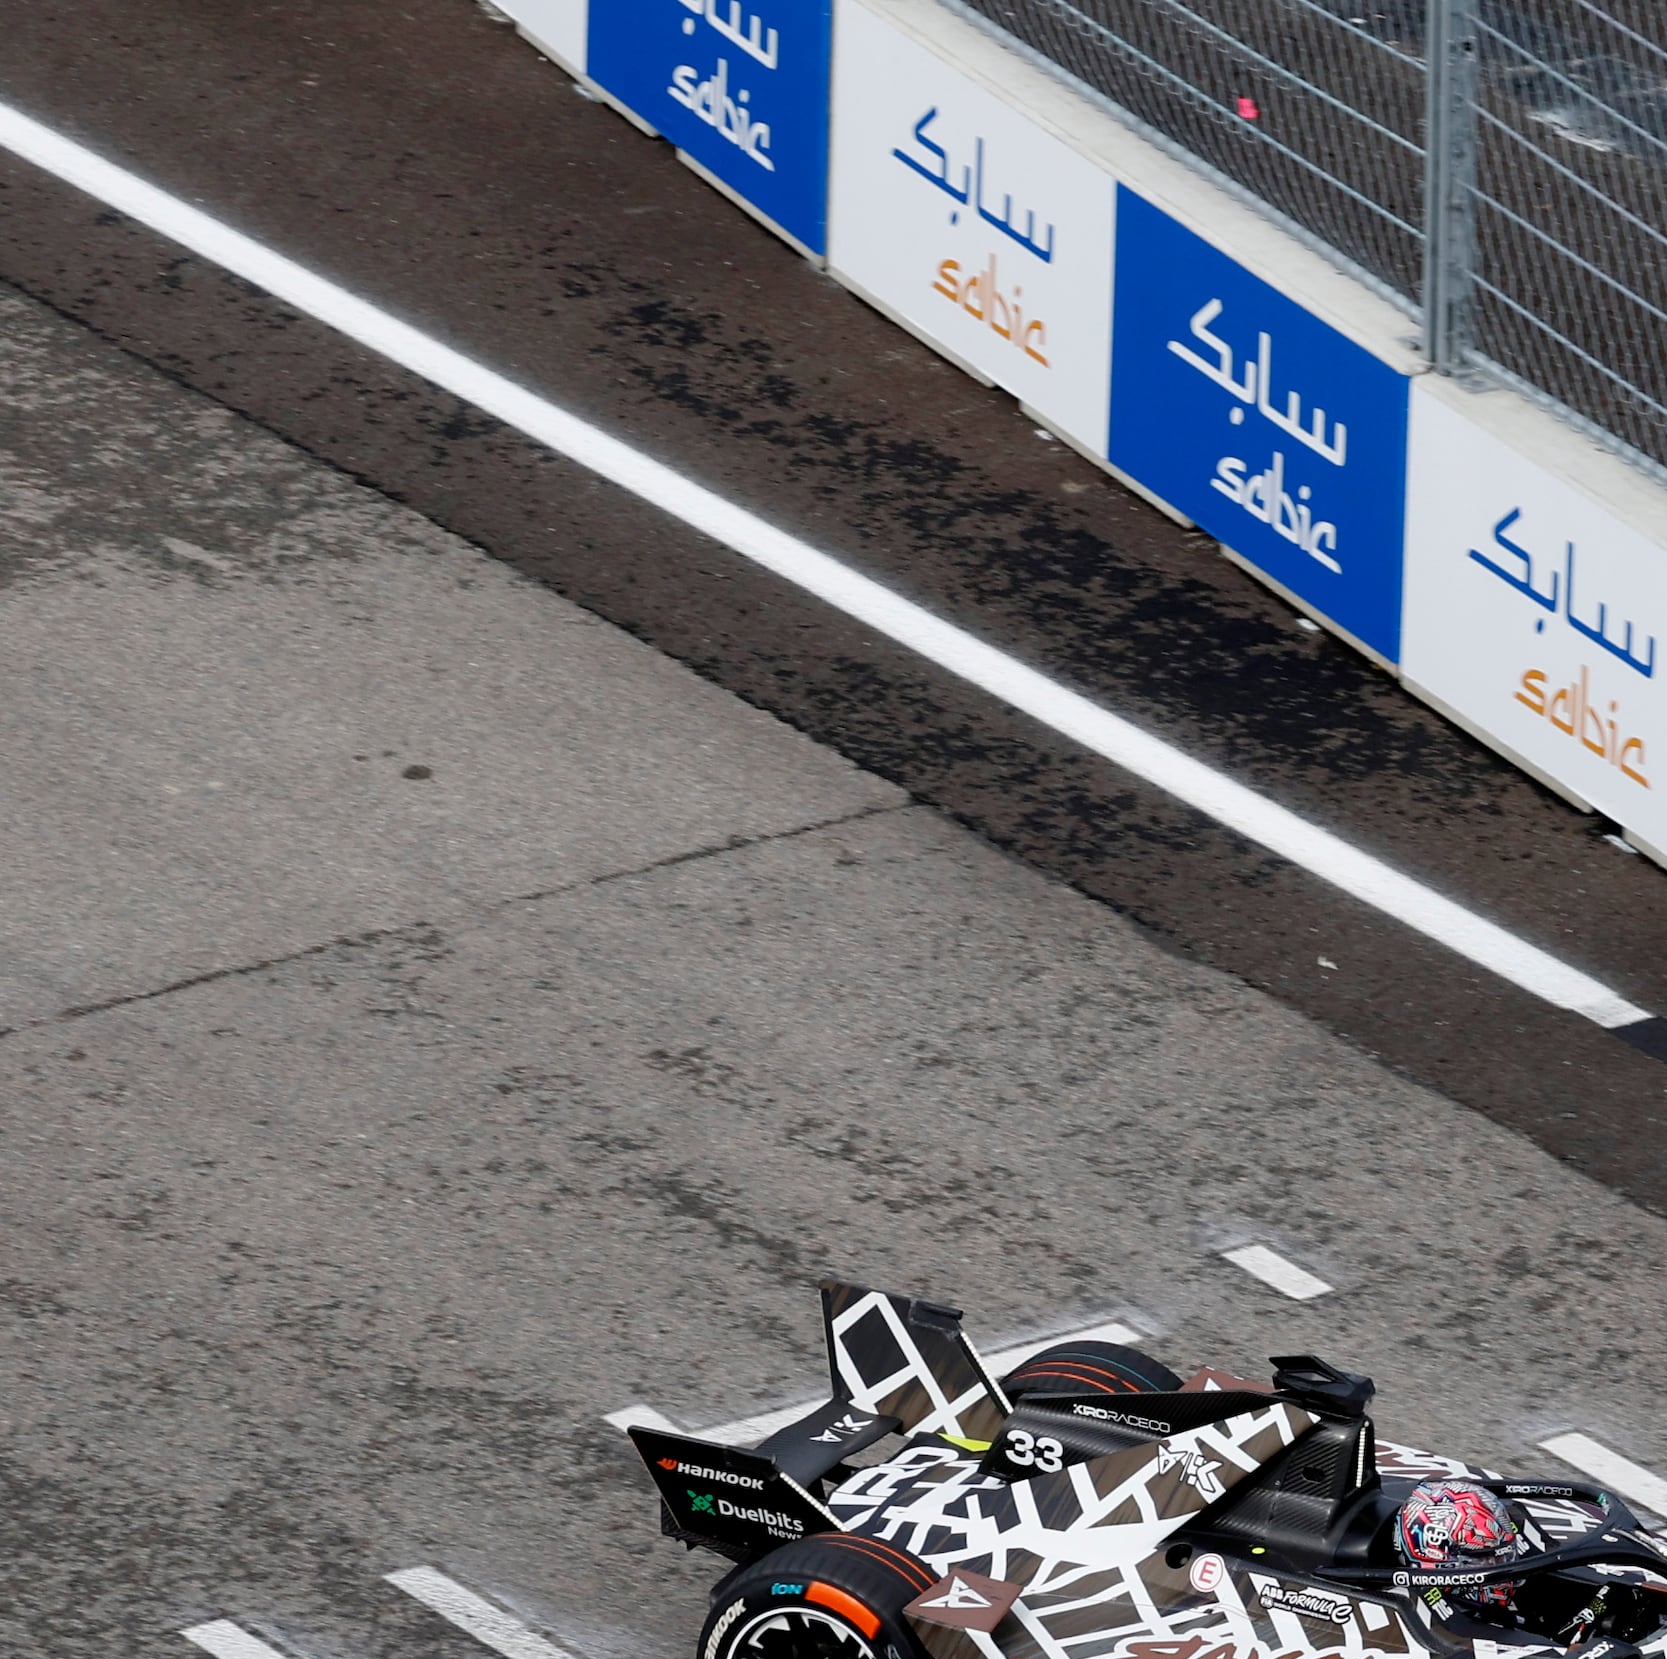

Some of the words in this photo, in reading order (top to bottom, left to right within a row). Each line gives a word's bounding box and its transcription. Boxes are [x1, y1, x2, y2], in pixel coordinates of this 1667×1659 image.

[667, 58, 775, 172] sabic
[893, 108, 1053, 263] سابك
[933, 255, 1048, 367] sabic
[1168, 298, 1346, 467] سابك
[1211, 453, 1341, 573] sabic
[1468, 508, 1655, 678] سابك
[1514, 666, 1651, 788] sabic
[1005, 1429, 1064, 1473] 33
[717, 1499, 804, 1532] Duelbits
[1198, 1561, 1218, 1584] E
[1261, 1585, 1284, 1600] ABB
[1283, 1590, 1336, 1616] FORMULA
[1411, 1572, 1485, 1586] KIRORACECO
